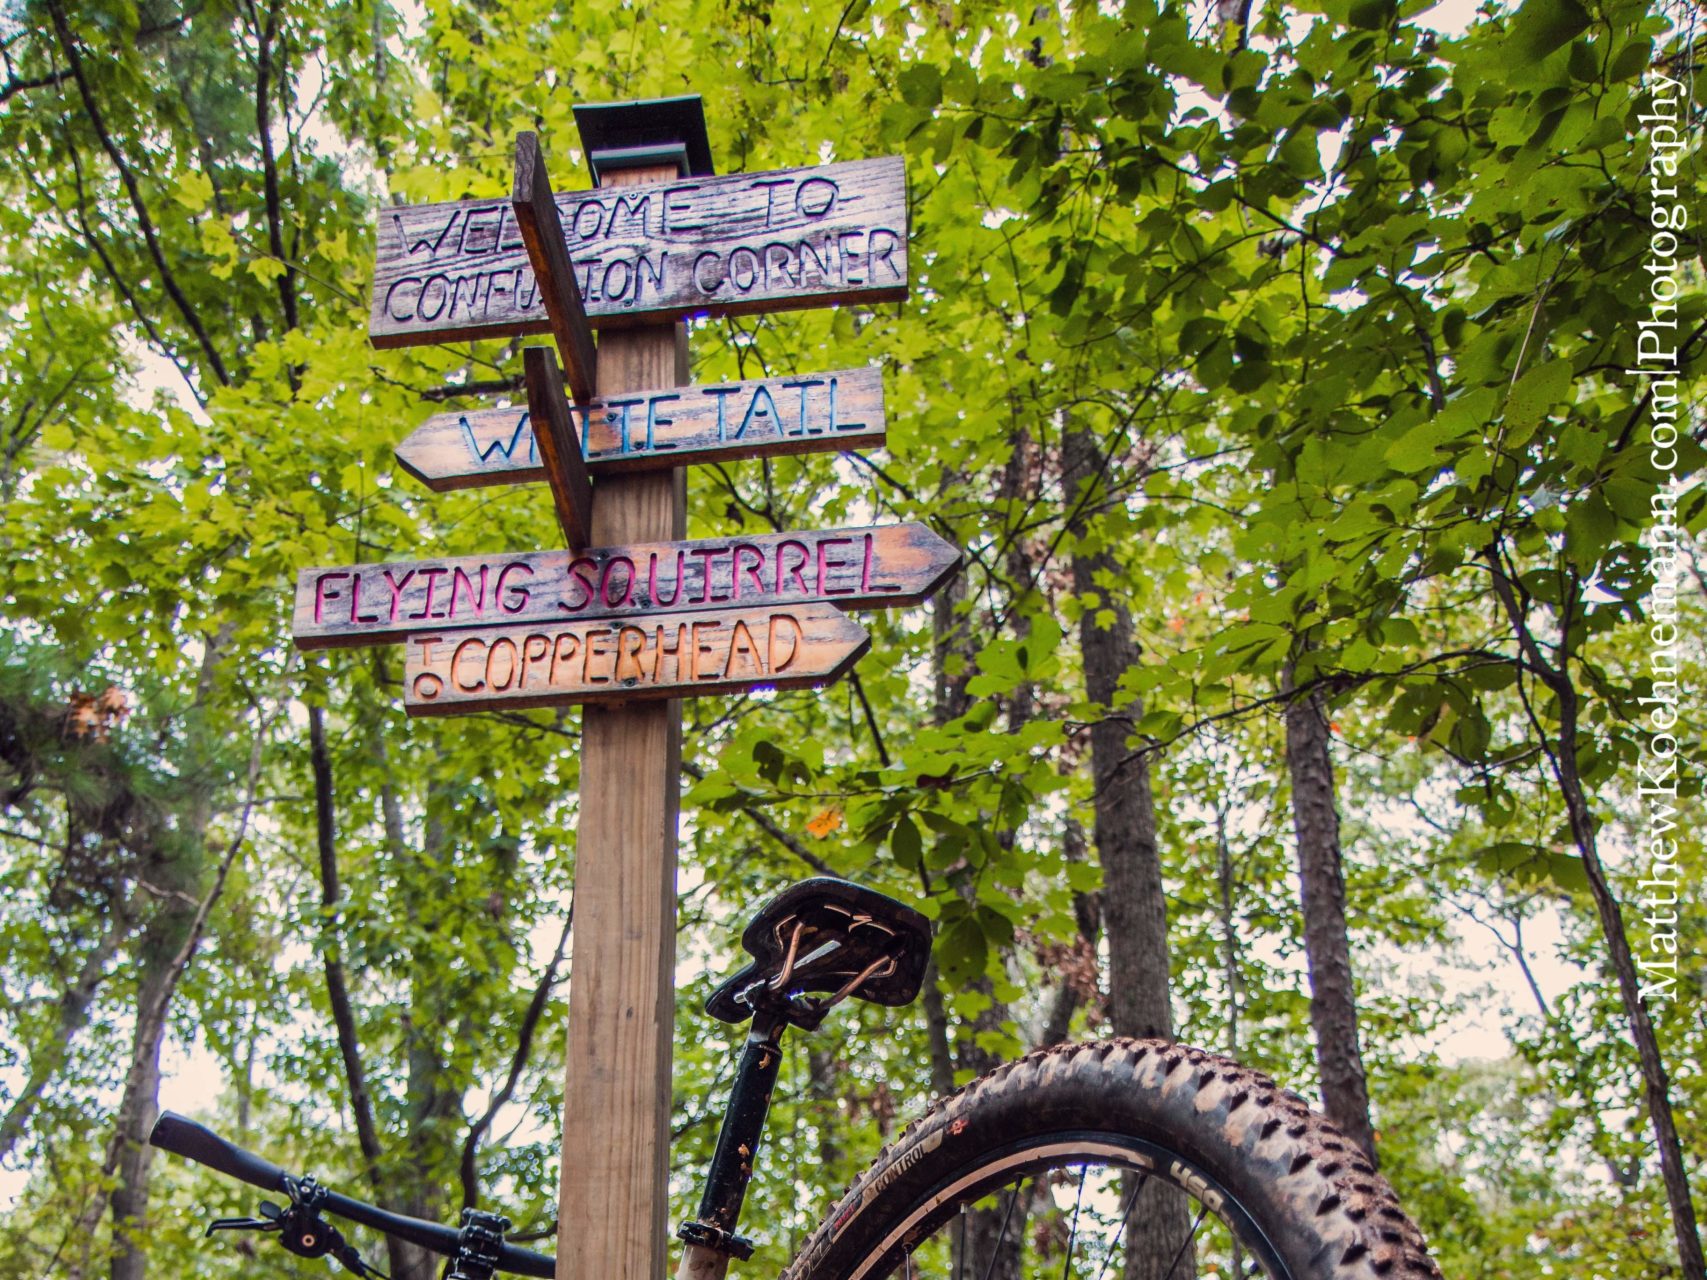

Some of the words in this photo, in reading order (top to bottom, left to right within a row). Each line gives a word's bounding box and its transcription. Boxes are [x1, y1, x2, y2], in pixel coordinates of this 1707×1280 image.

[392, 184, 701, 259] WELOME
[750, 177, 841, 229] TO
[384, 250, 668, 324] CONFUION
[694, 227, 902, 294] CORNER
[702, 377, 867, 442] TAIL
[313, 561, 535, 626] FLYING
[557, 532, 903, 612] SQUIRREL
[450, 612, 804, 693] COPPERHEAD
